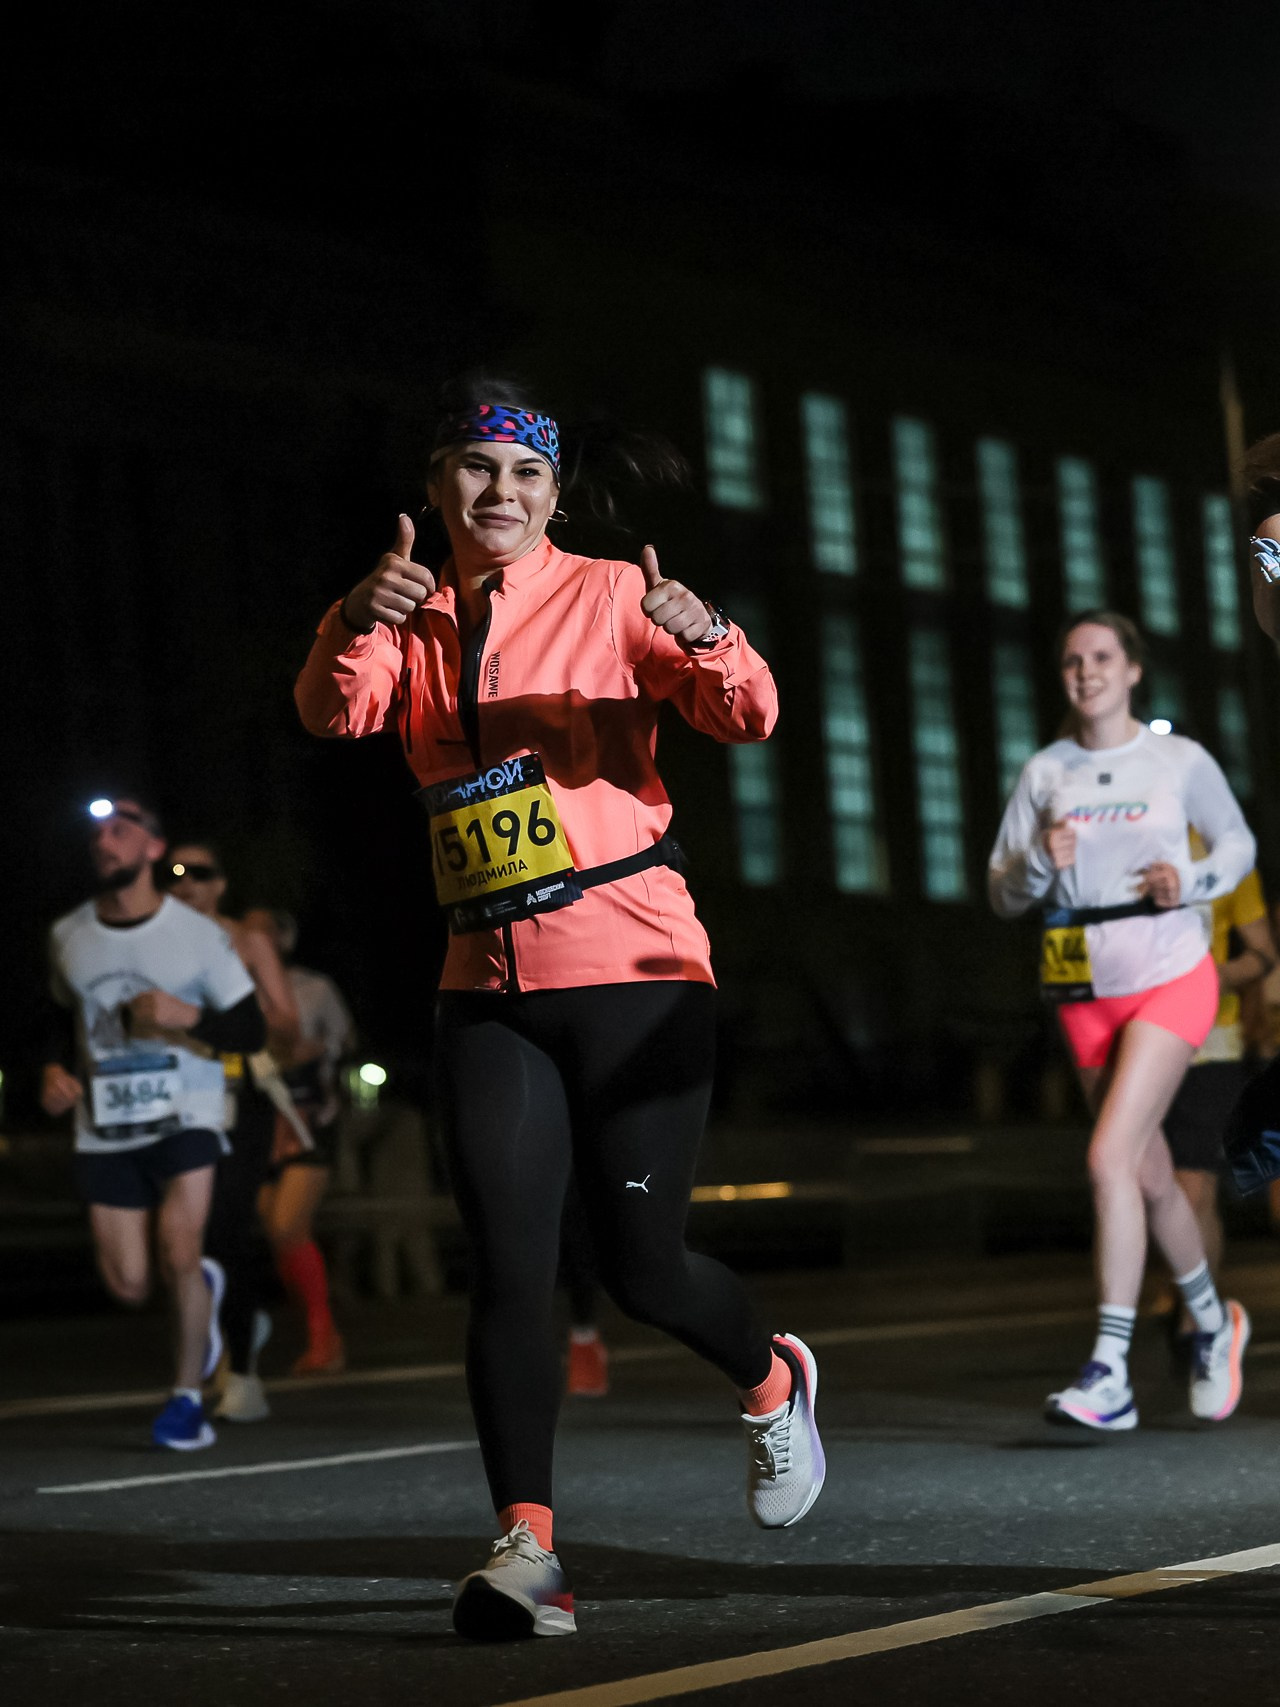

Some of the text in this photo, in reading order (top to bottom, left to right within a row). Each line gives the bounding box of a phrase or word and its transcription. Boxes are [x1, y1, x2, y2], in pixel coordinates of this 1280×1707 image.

[488, 651, 501, 698] WOSAWE
[1065, 801, 1149, 824] AVITO
[457, 859, 529, 890] ЛЮДМИЛА
